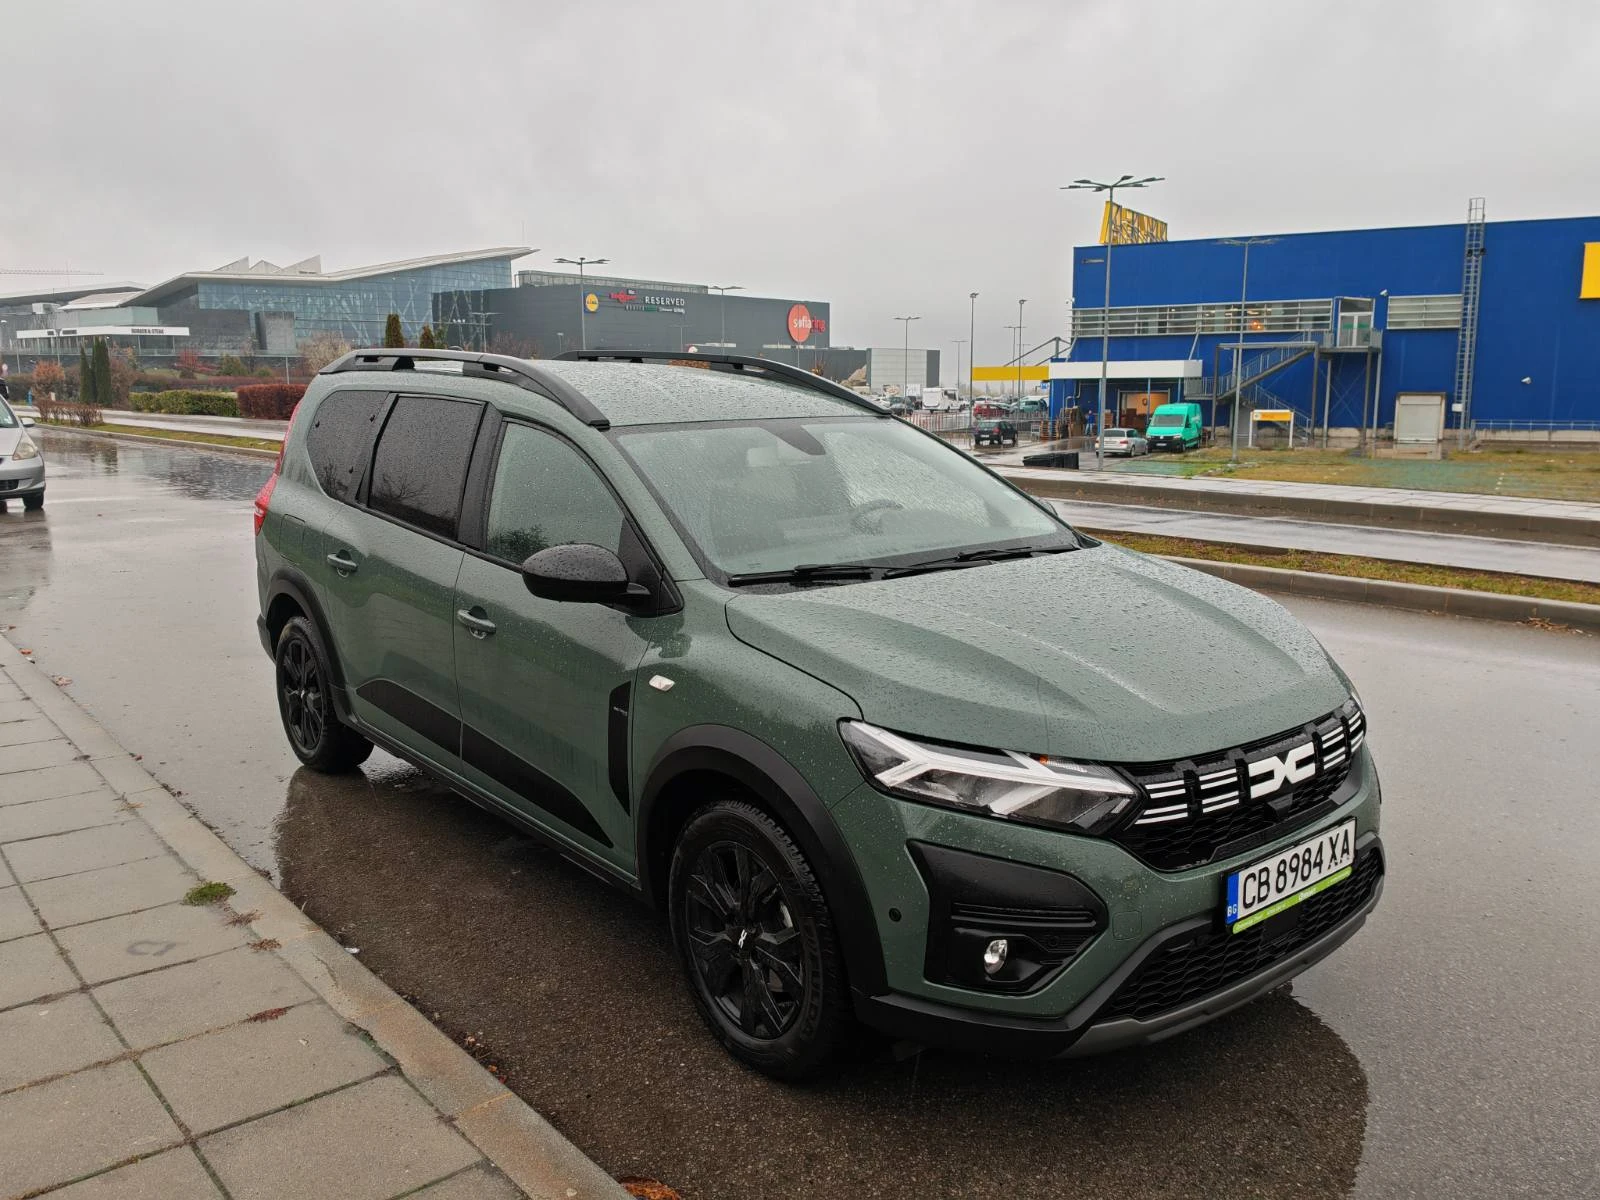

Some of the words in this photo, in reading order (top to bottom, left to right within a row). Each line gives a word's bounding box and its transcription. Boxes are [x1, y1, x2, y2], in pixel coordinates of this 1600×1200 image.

[645, 296, 685, 306] RESERVED
[1243, 866, 1270, 909] CB
[1275, 841, 1324, 894] 8984
[1327, 829, 1350, 870] XA
[1226, 903, 1238, 917] BG
